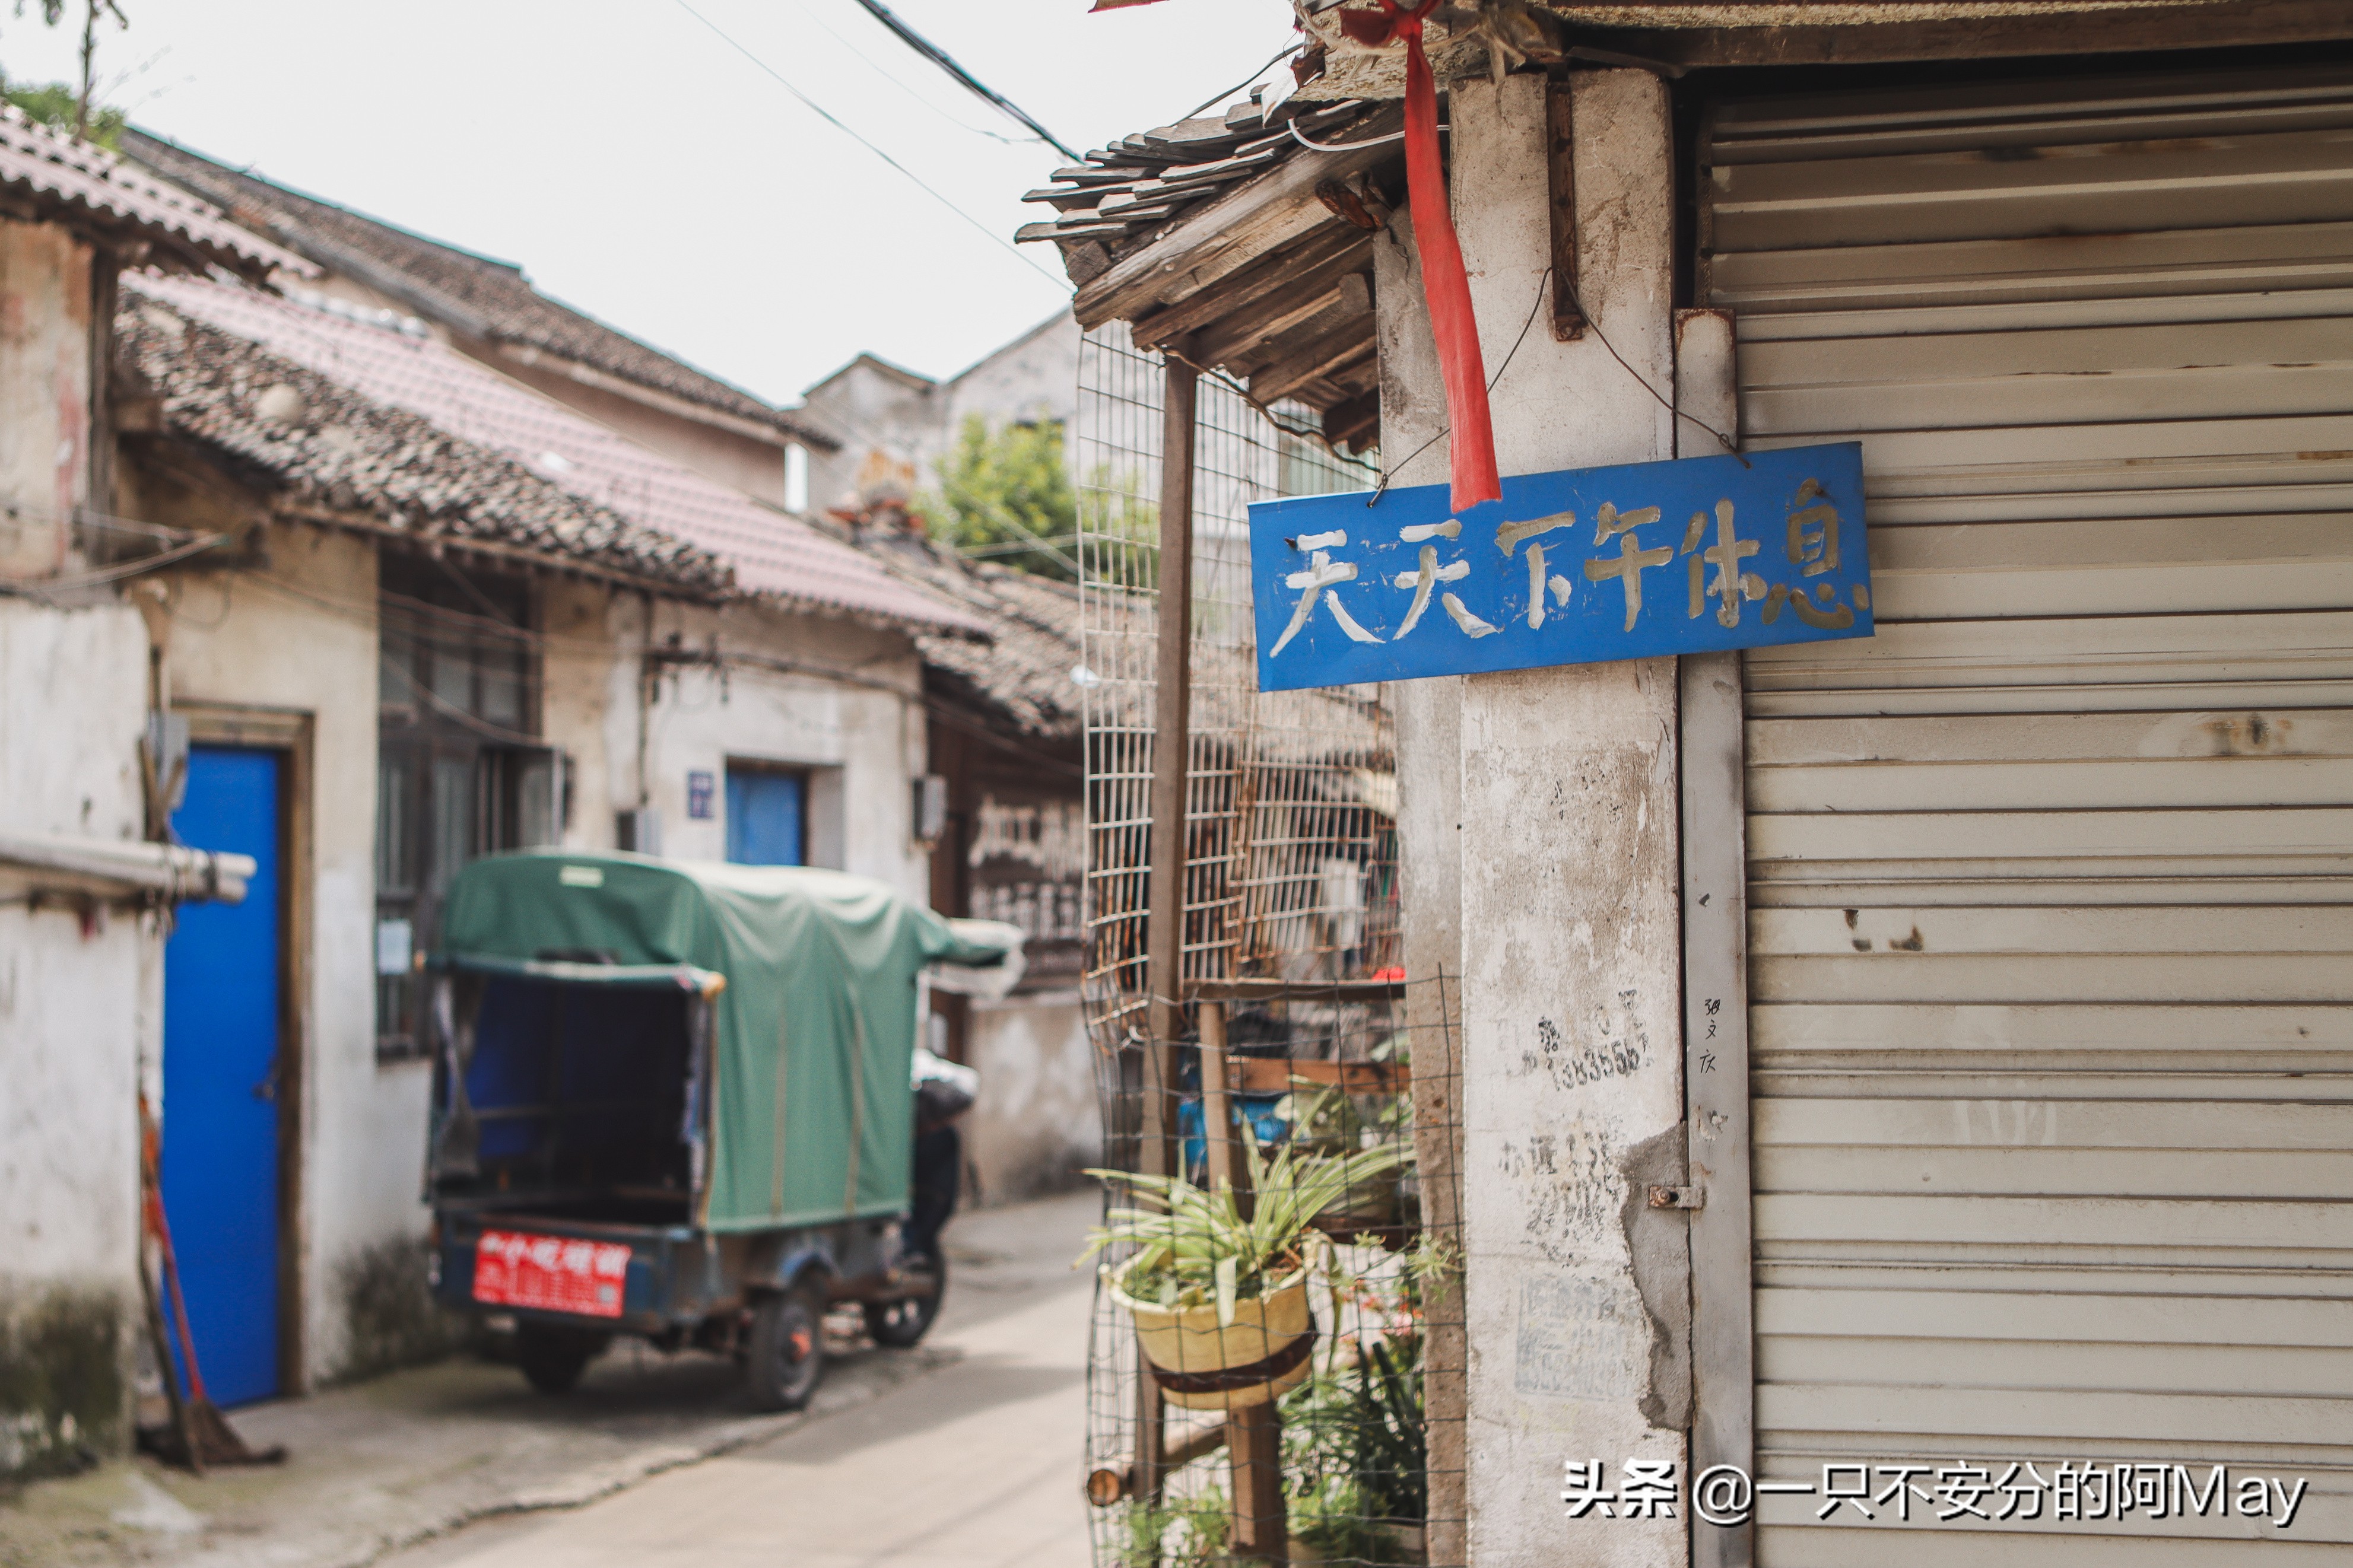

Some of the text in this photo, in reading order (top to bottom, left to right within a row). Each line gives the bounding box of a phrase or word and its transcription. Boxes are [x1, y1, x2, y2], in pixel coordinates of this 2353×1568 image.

[1269, 477, 1869, 658] 天天下午休息
